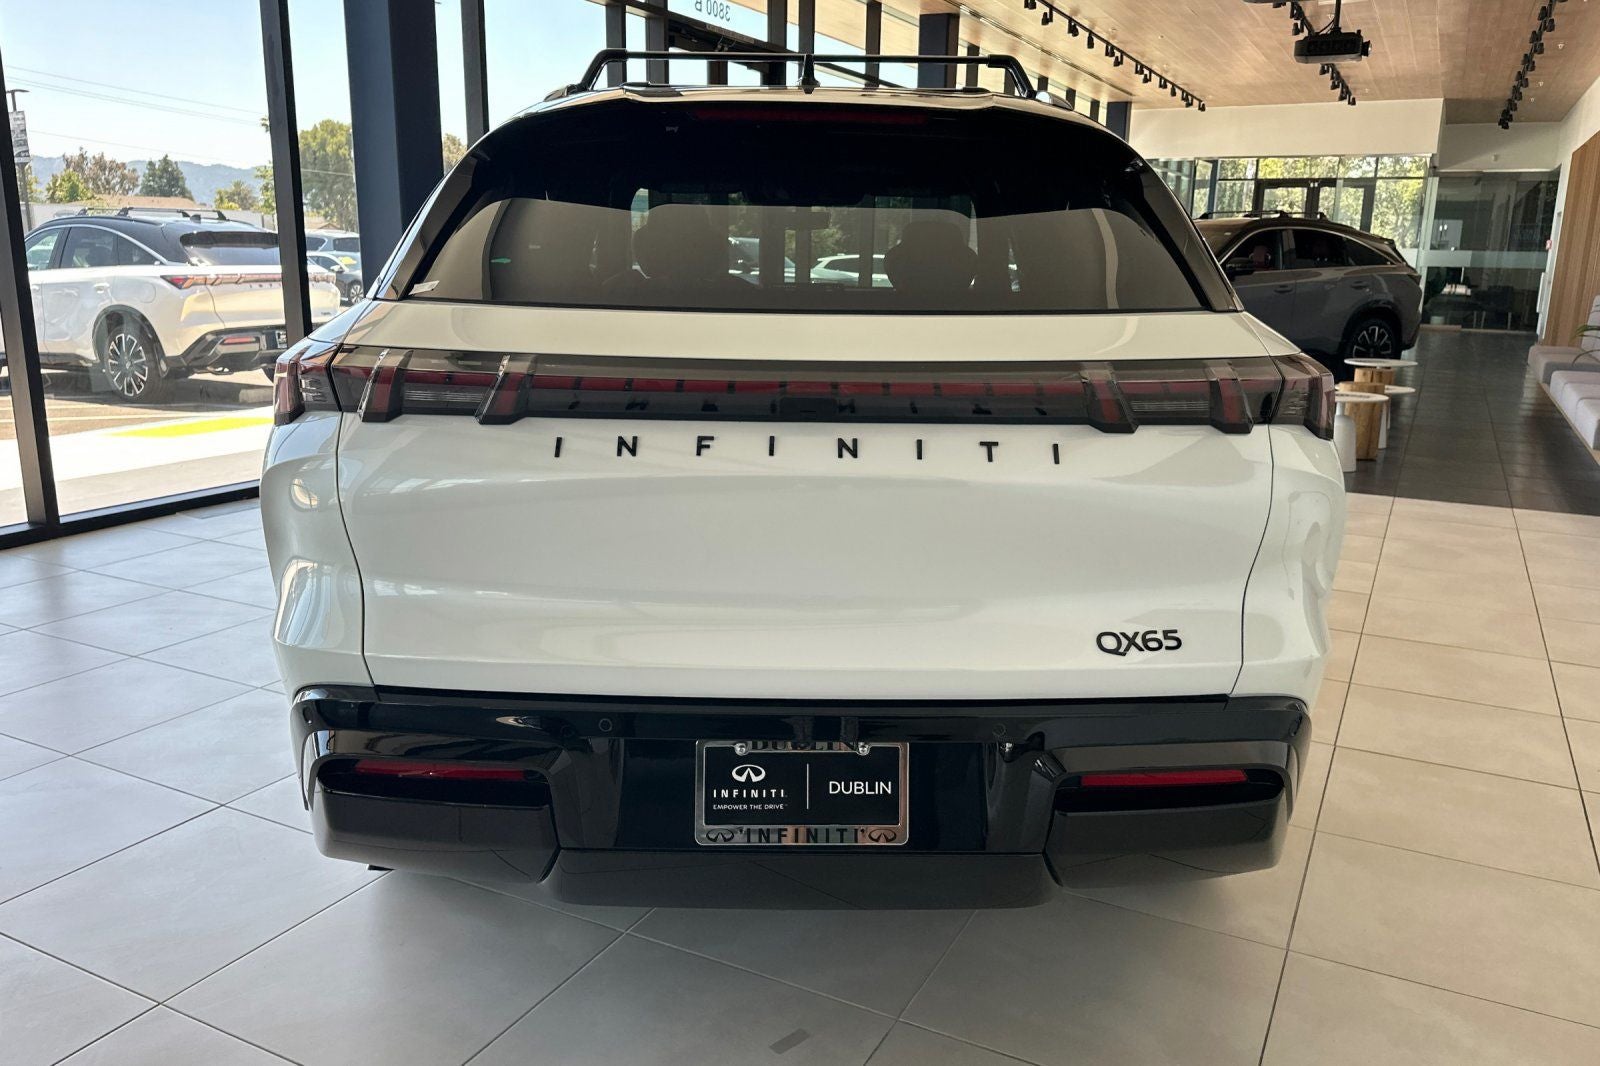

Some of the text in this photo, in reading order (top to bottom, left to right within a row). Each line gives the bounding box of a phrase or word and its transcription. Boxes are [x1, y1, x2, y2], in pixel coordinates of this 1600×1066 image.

[554, 435, 1061, 465] INFINITI
[1095, 628, 1183, 657] QX65
[713, 789, 784, 798] INFINITI
[829, 780, 892, 795] DUBLIN
[746, 827, 859, 844] INFINITI
